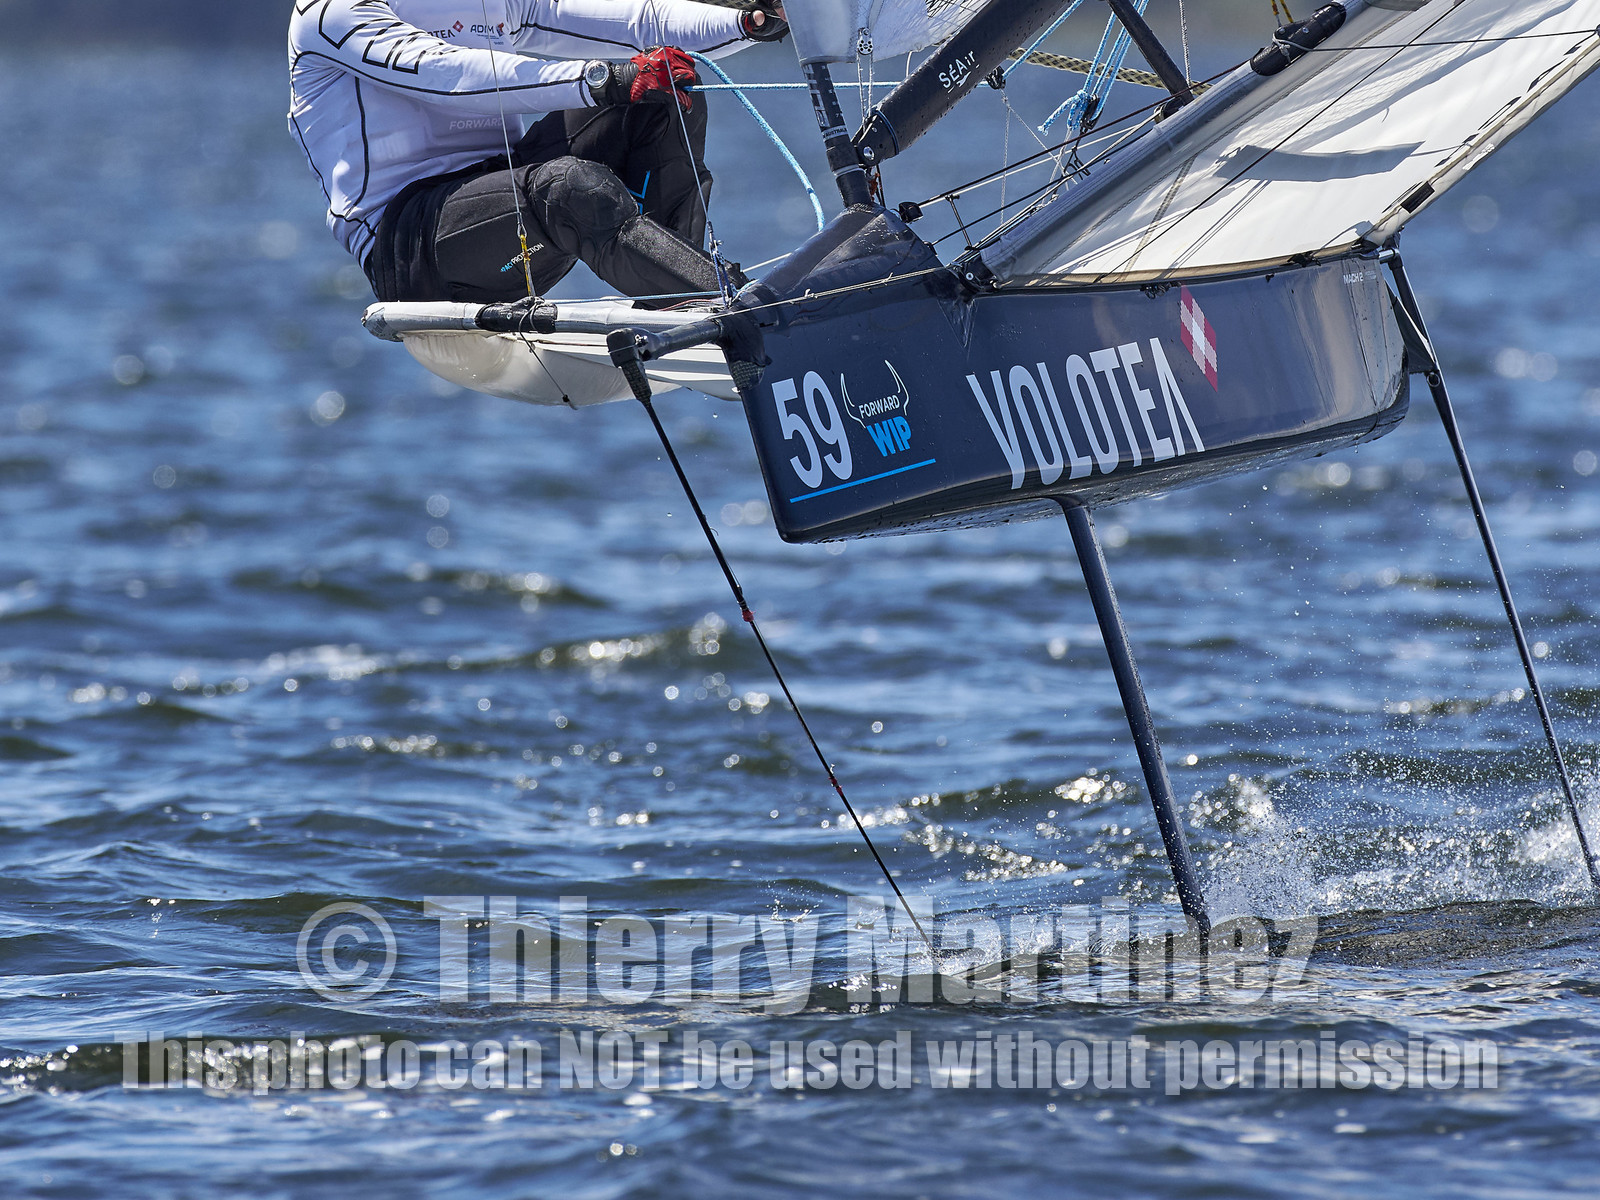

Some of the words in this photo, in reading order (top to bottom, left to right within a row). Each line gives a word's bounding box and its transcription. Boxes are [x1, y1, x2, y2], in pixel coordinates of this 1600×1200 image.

[771, 370, 853, 489] 59
[858, 394, 900, 419] FORWARD
[866, 415, 912, 457] WIP
[965, 337, 1205, 490] VOLOTEA
